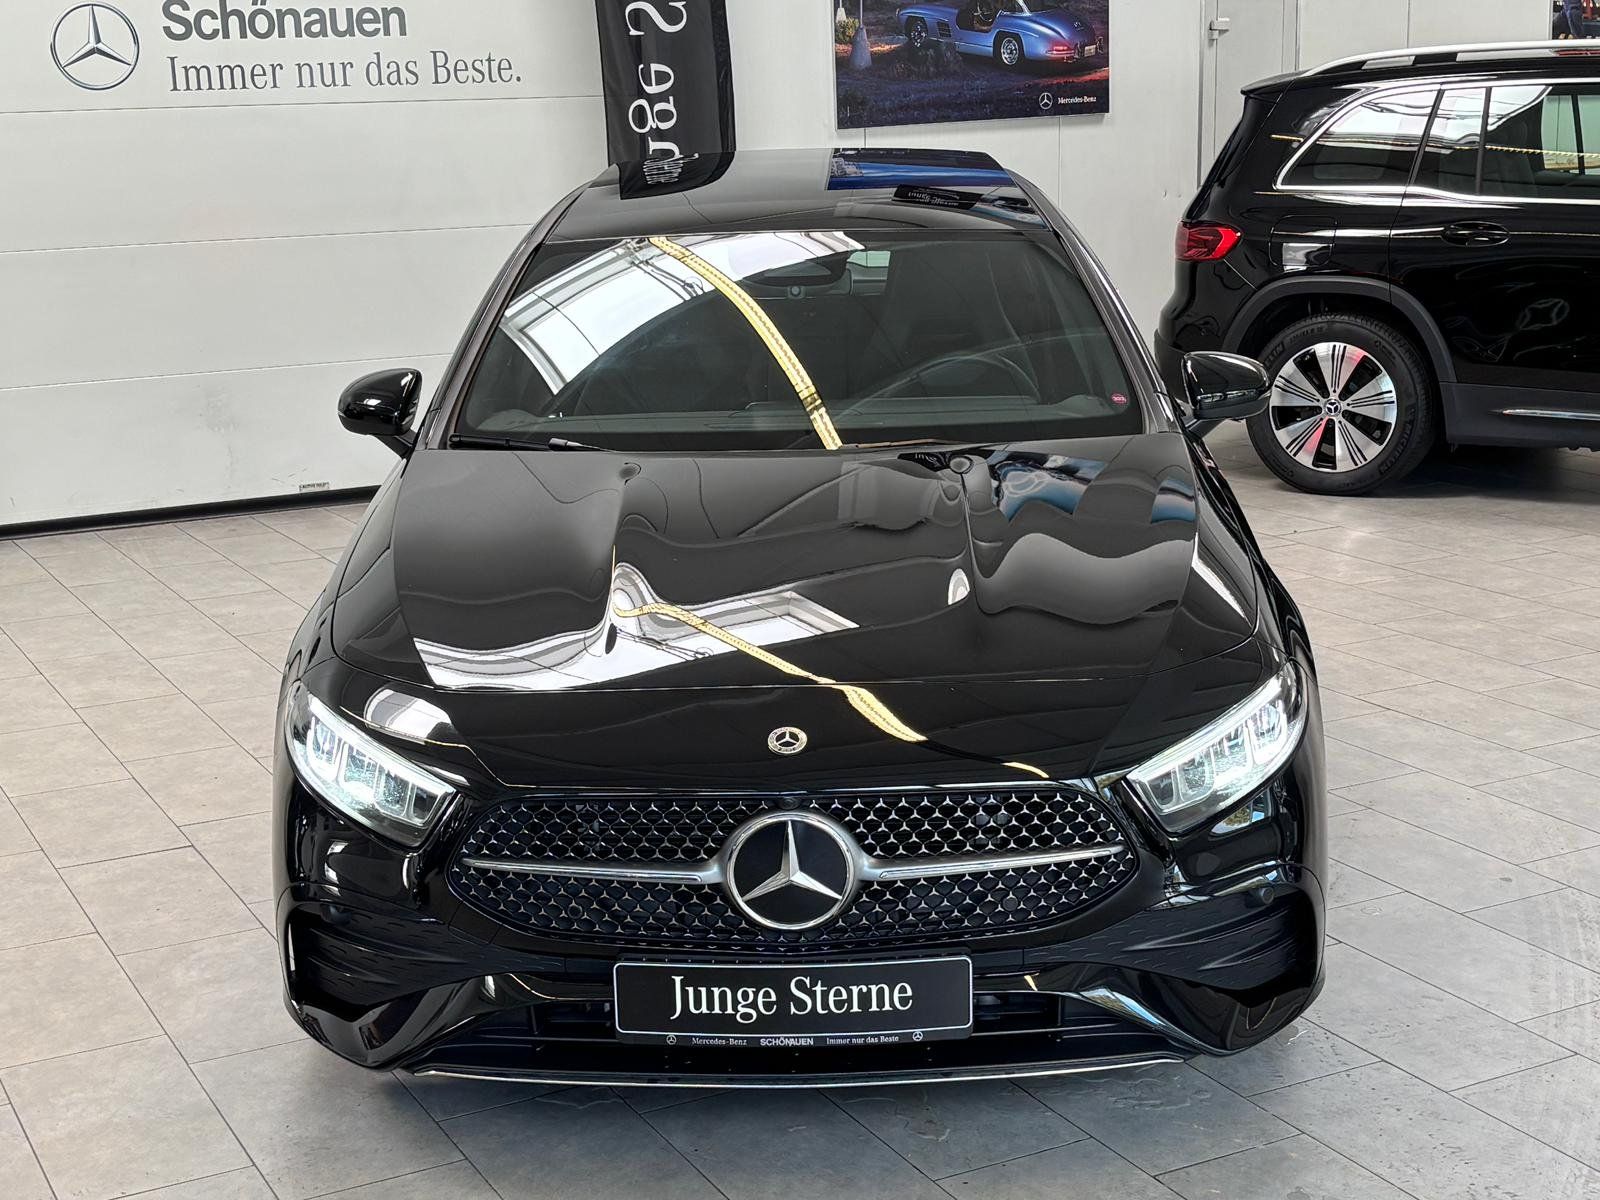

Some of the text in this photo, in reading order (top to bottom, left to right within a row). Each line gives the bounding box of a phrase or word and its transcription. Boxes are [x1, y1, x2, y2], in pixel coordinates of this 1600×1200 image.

[161, 0, 407, 42] Schönauen
[167, 49, 522, 92] Immer nur das Beste.
[1058, 95, 1096, 105] Mercedes-Benz
[670, 975, 913, 1024] Junge Sterne
[691, 1037, 748, 1046] Mercedes-Benz
[759, 1035, 814, 1047] SCHÖNAUEN
[826, 1036, 850, 1045] Immer
[865, 1036, 879, 1044] das
